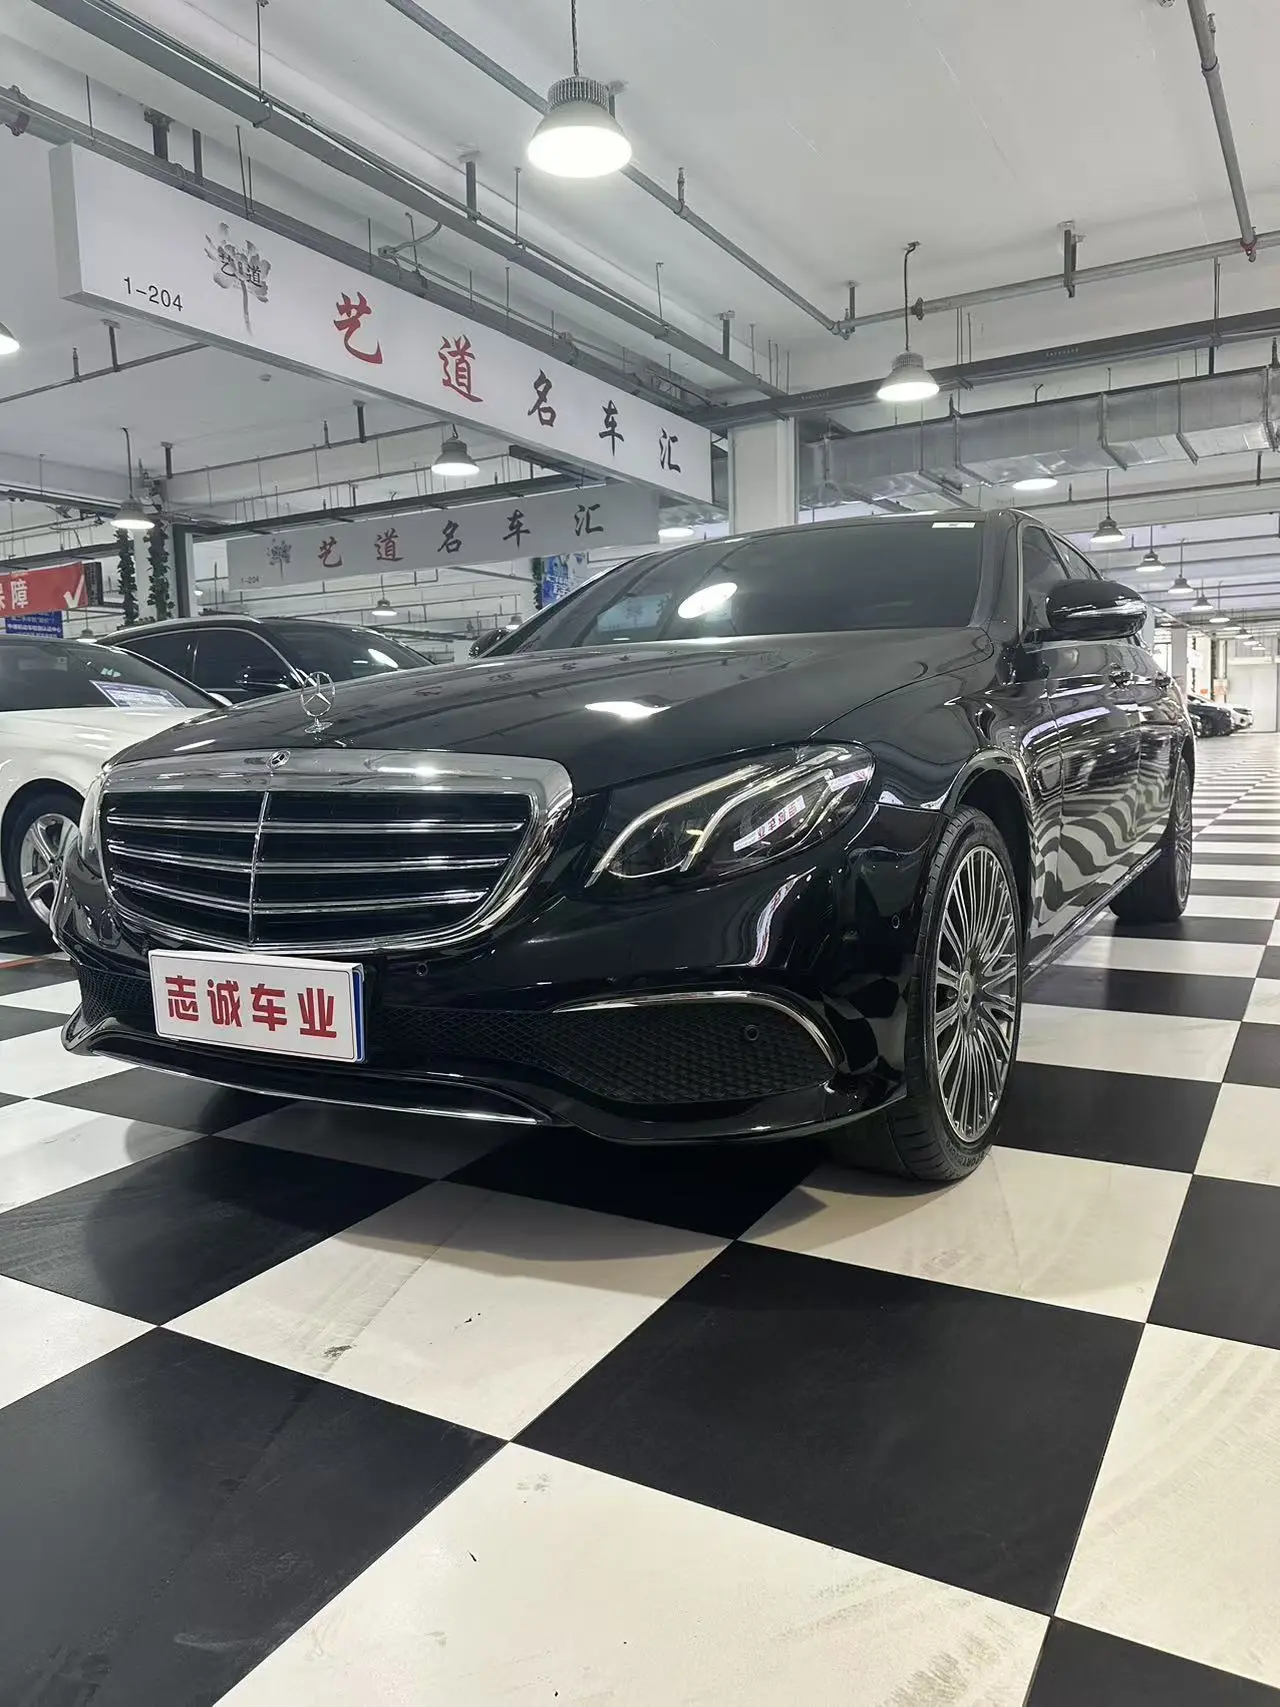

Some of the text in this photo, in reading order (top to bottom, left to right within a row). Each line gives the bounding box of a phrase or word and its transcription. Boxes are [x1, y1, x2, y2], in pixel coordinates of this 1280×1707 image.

[124, 276, 184, 312] 1-204
[333, 291, 681, 473] 艺道名车汇
[318, 503, 605, 568] 艺道名车汇
[164, 974, 338, 1039] 志诚车业
